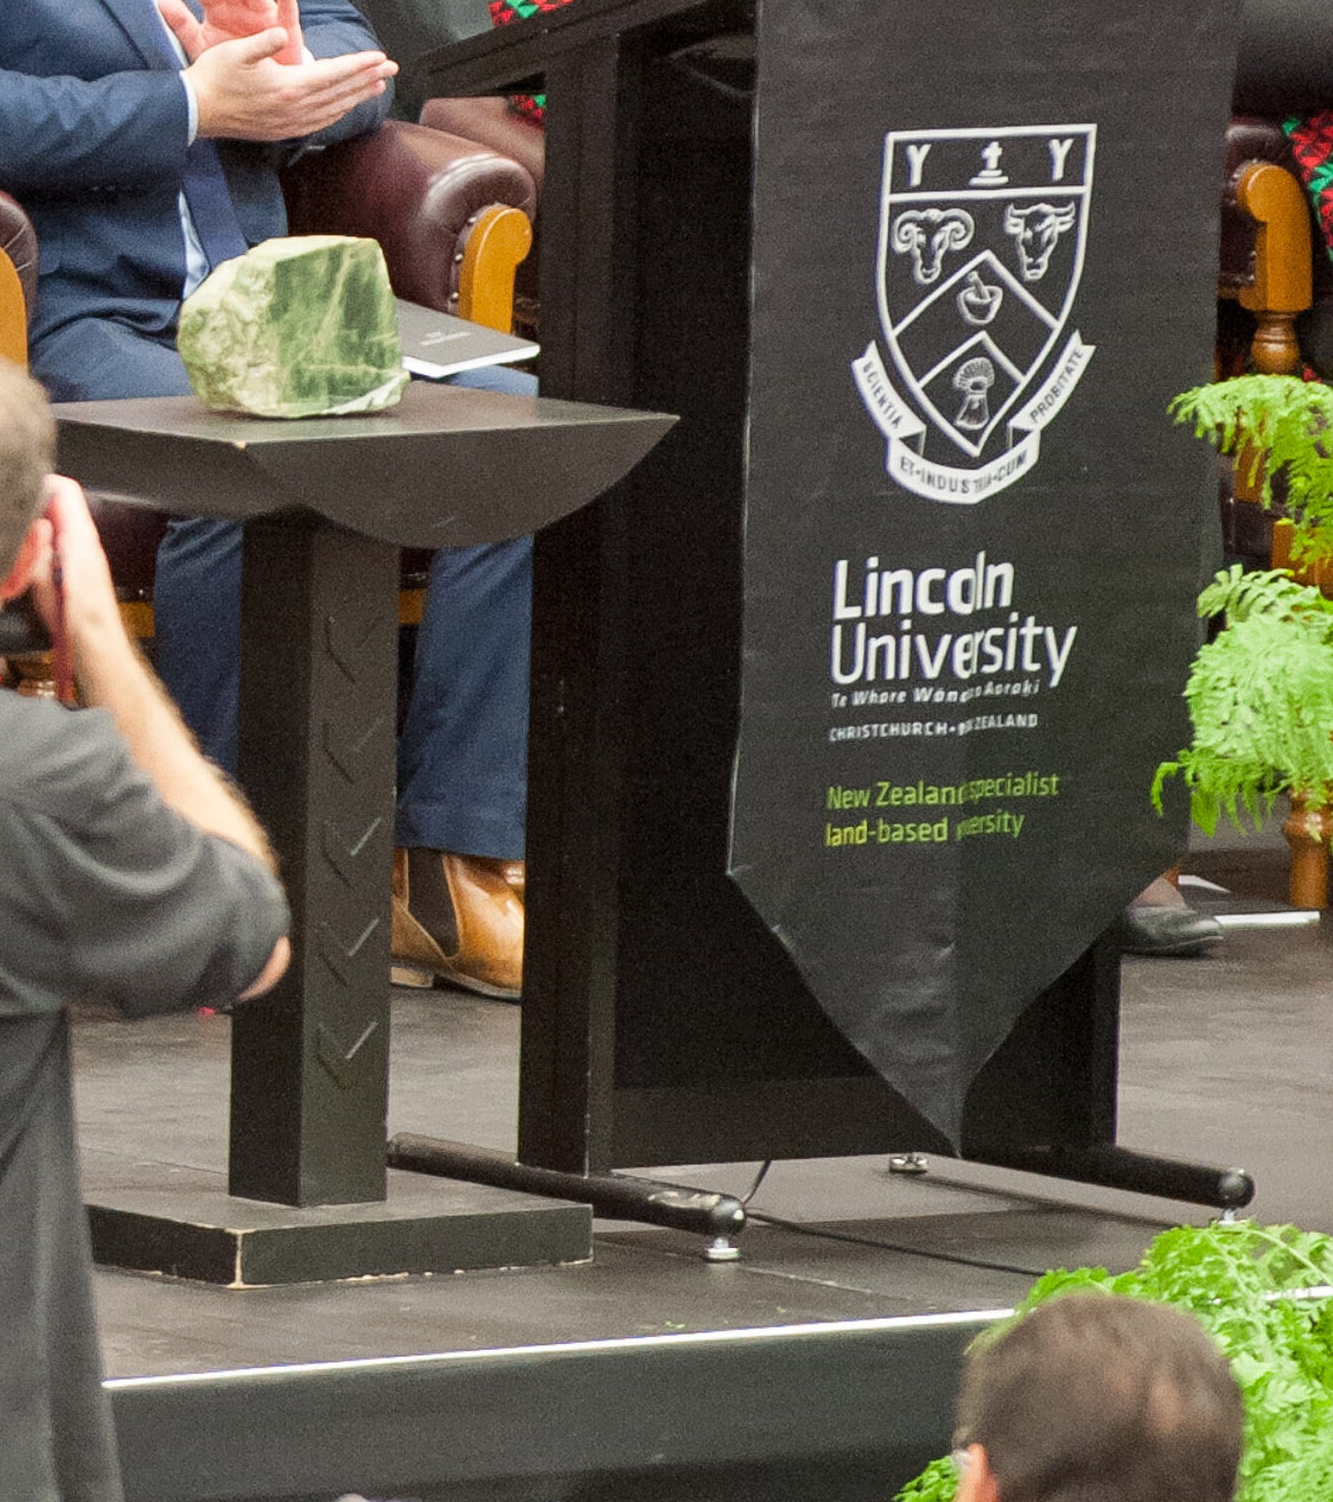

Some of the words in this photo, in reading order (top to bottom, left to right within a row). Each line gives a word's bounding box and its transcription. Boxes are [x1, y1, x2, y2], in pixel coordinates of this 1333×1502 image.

[863, 361, 903, 429] SCIENTIA
[1029, 347, 1083, 424] PROBITATE
[833, 550, 1014, 620] Lincoln
[830, 611, 1078, 688] University
[975, 714, 1039, 731] ZEALAND
[826, 785, 870, 810] New
[969, 772, 1059, 805] specialist
[825, 816, 949, 847] land-based
